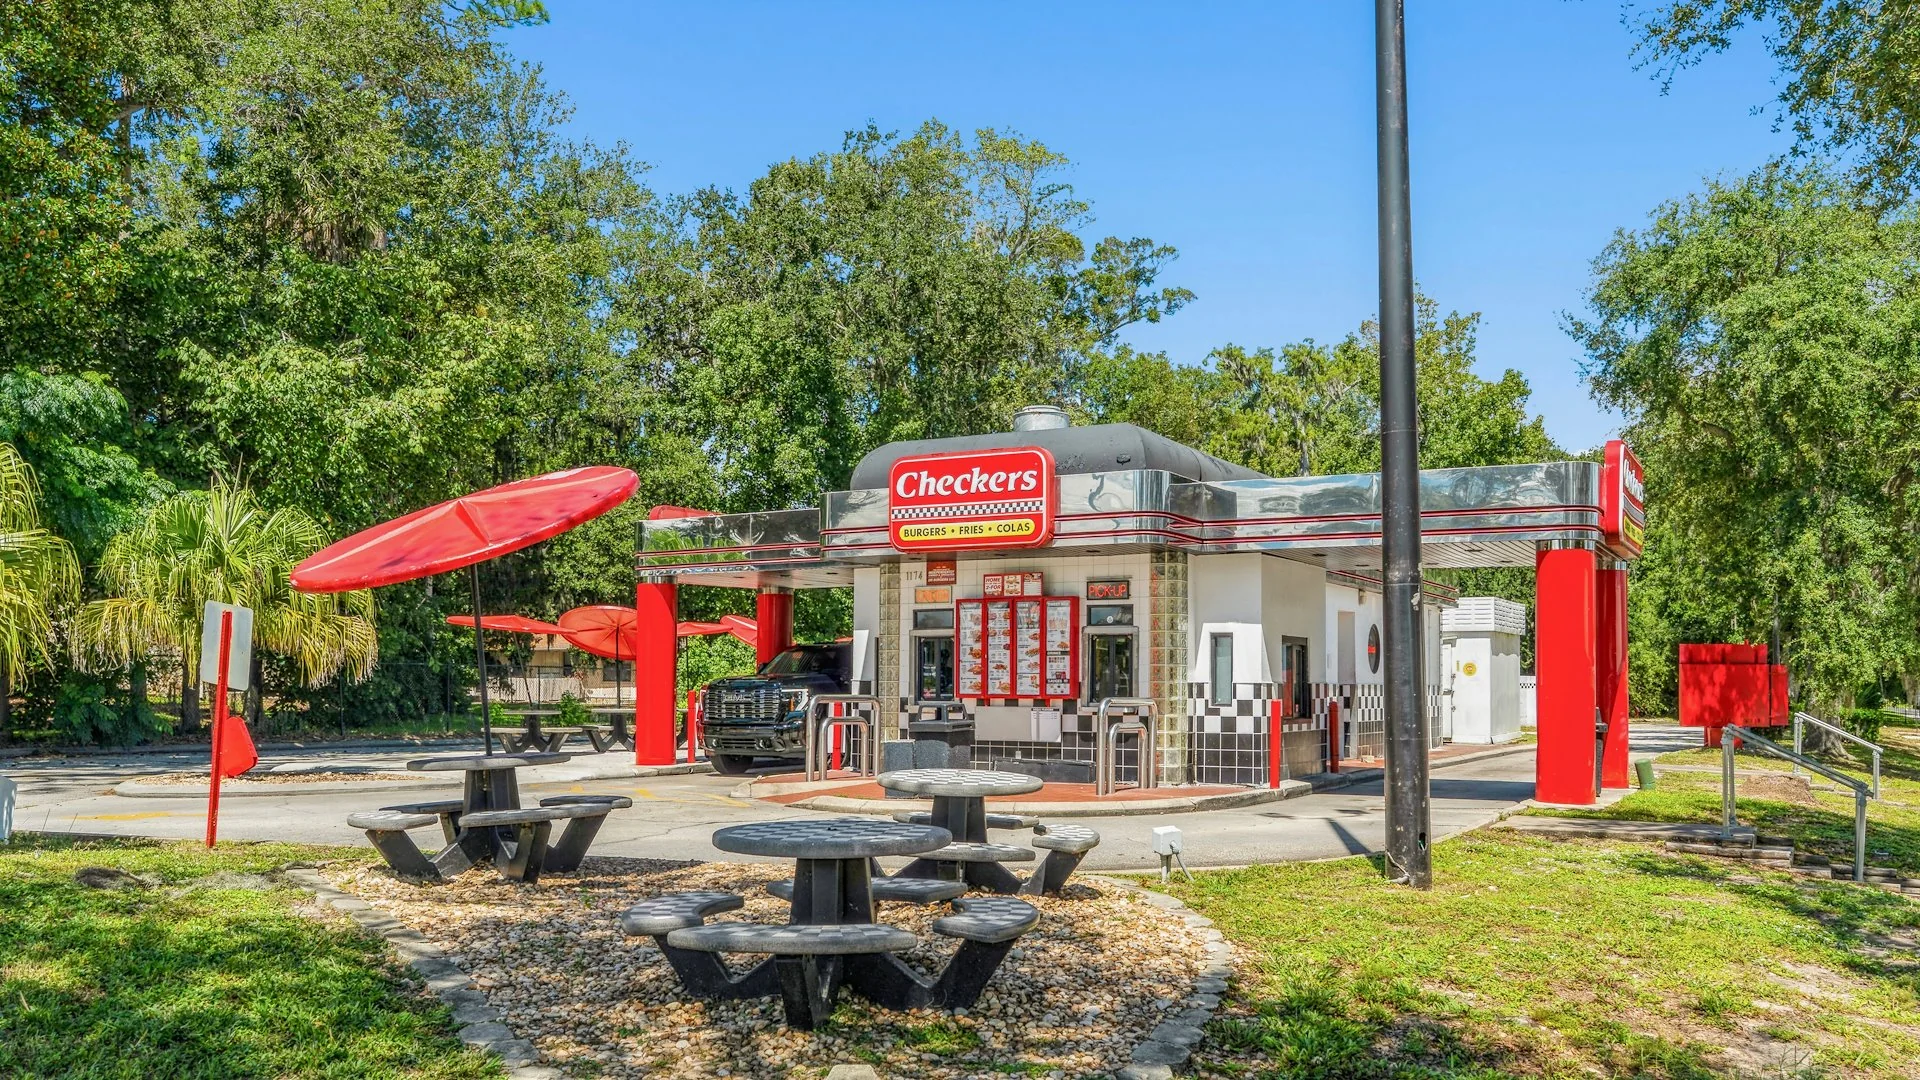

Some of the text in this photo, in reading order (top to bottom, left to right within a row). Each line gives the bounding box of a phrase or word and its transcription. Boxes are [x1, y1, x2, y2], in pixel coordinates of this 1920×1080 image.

[896, 467, 1038, 498] Checkers
[904, 522, 1030, 538] BURGERS FRIES COLAS
